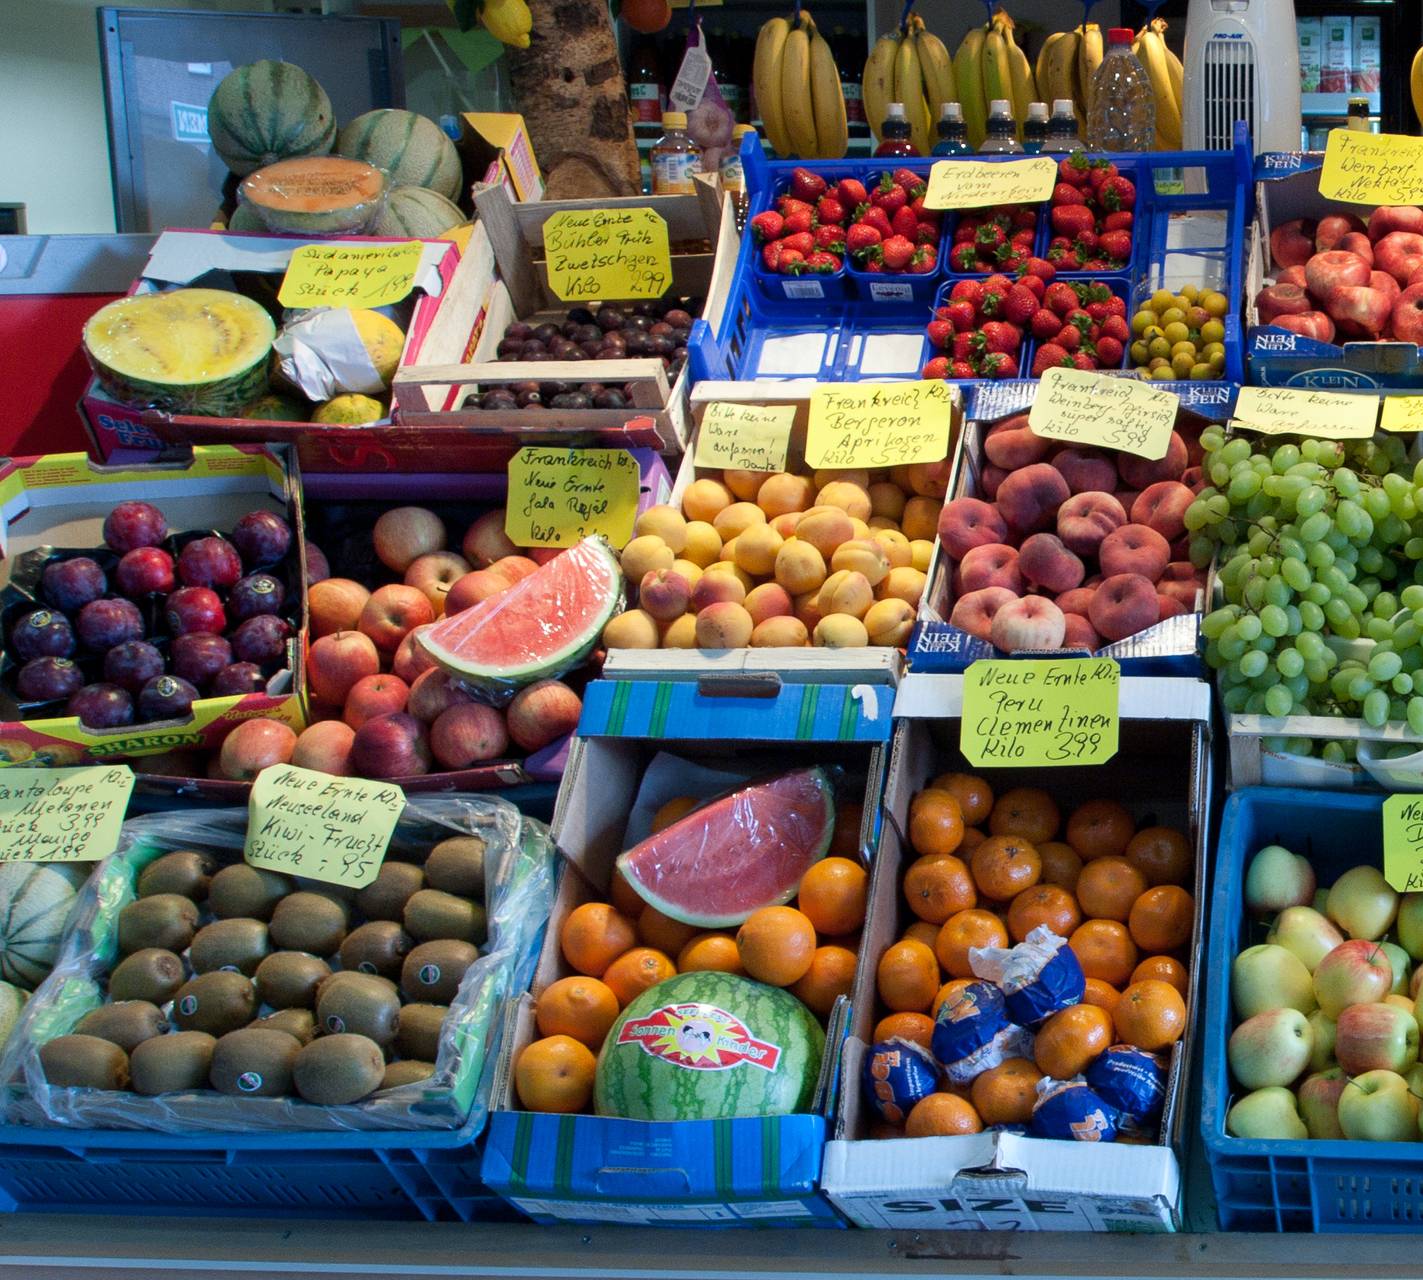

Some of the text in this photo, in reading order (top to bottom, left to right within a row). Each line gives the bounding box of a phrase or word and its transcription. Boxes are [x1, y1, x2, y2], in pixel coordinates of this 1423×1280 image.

[1265, 160, 1302, 169] FEIN
[1334, 188, 1366, 200] Kilo
[553, 212, 633, 229] Neue Ernte
[555, 250, 659, 272] Zwetschgen
[314, 263, 388, 280] Papaya
[296, 281, 360, 297] Stück
[565, 275, 600, 297] Kilo
[1304, 374, 1361, 389] KLEIN
[1189, 394, 1229, 404] FEIN
[708, 422, 740, 438] Ware
[1041, 420, 1079, 437] Kilo
[521, 448, 612, 471] Frankreich
[819, 448, 855, 466] Kilo
[531, 521, 561, 542] Kilo
[979, 664, 1088, 686] Neue Ernte
[989, 690, 1043, 714] Peru
[976, 705, 1111, 737] Clementinen
[88, 733, 201, 757] SHARON
[981, 736, 1025, 759] Kilo
[273, 771, 369, 803] Neue Ernte
[14, 799, 113, 817] Melonen
[266, 794, 368, 825] Neuseeland
[0, 818, 38, 834] ück
[323, 823, 385, 858] Frucht
[0, 846, 35, 860] ück
[249, 840, 305, 866] Stück
[630, 1024, 768, 1060] Sonnen Kinder
[883, 1197, 1075, 1215] SIZE
